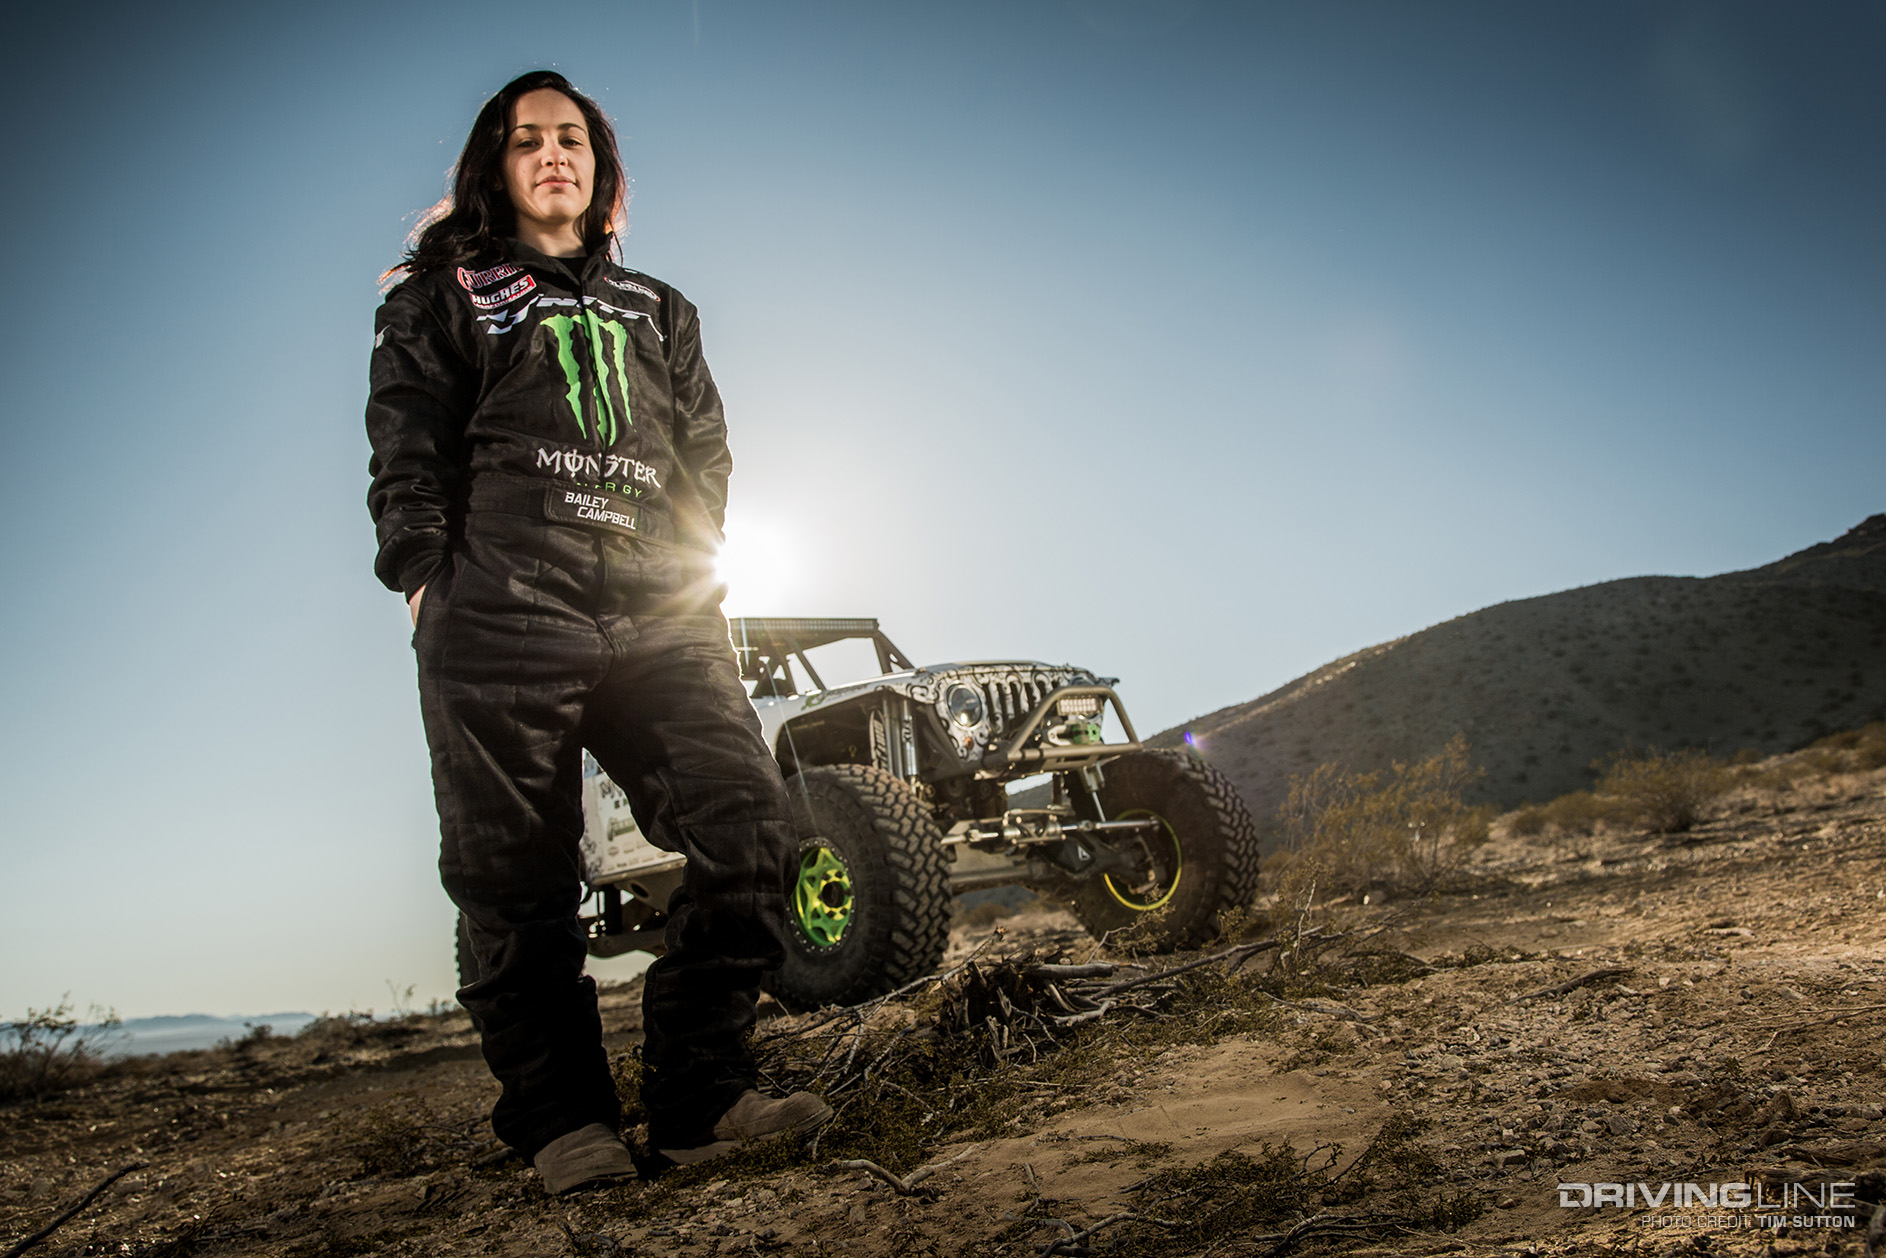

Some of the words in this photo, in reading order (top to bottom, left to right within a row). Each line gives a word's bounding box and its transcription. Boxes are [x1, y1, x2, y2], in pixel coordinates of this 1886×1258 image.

[457, 263, 524, 291] CURRI
[471, 277, 529, 305] HUGHES
[536, 447, 661, 488] MONSTER
[564, 491, 609, 510] BAILEY
[576, 481, 642, 498] RGY
[577, 506, 636, 530] CAMPBELL
